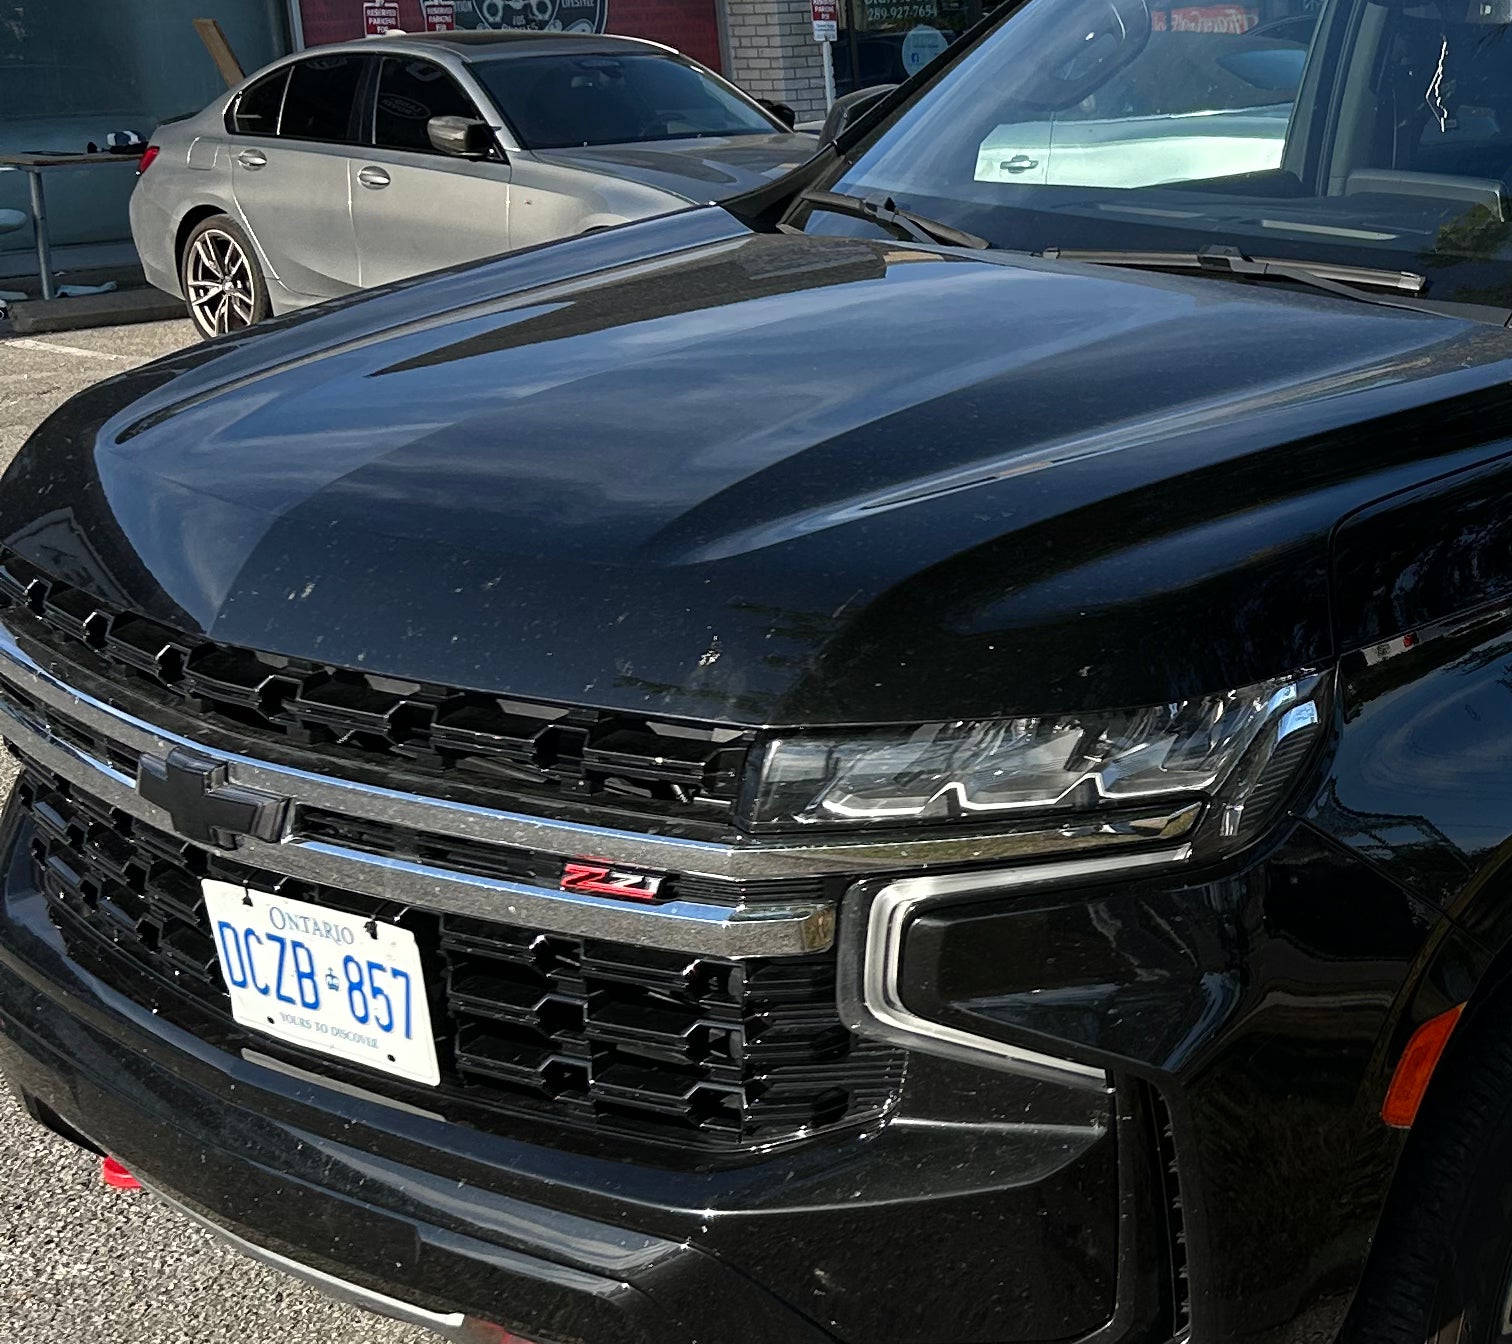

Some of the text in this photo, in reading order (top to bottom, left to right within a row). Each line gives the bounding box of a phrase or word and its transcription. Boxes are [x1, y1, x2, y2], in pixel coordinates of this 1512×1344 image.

[560, 862, 664, 900] Z71
[269, 906, 355, 946] ONTARIO
[217, 919, 413, 1040] DCZB 857
[280, 1011, 379, 1050] YOURS TO DISCOVER
